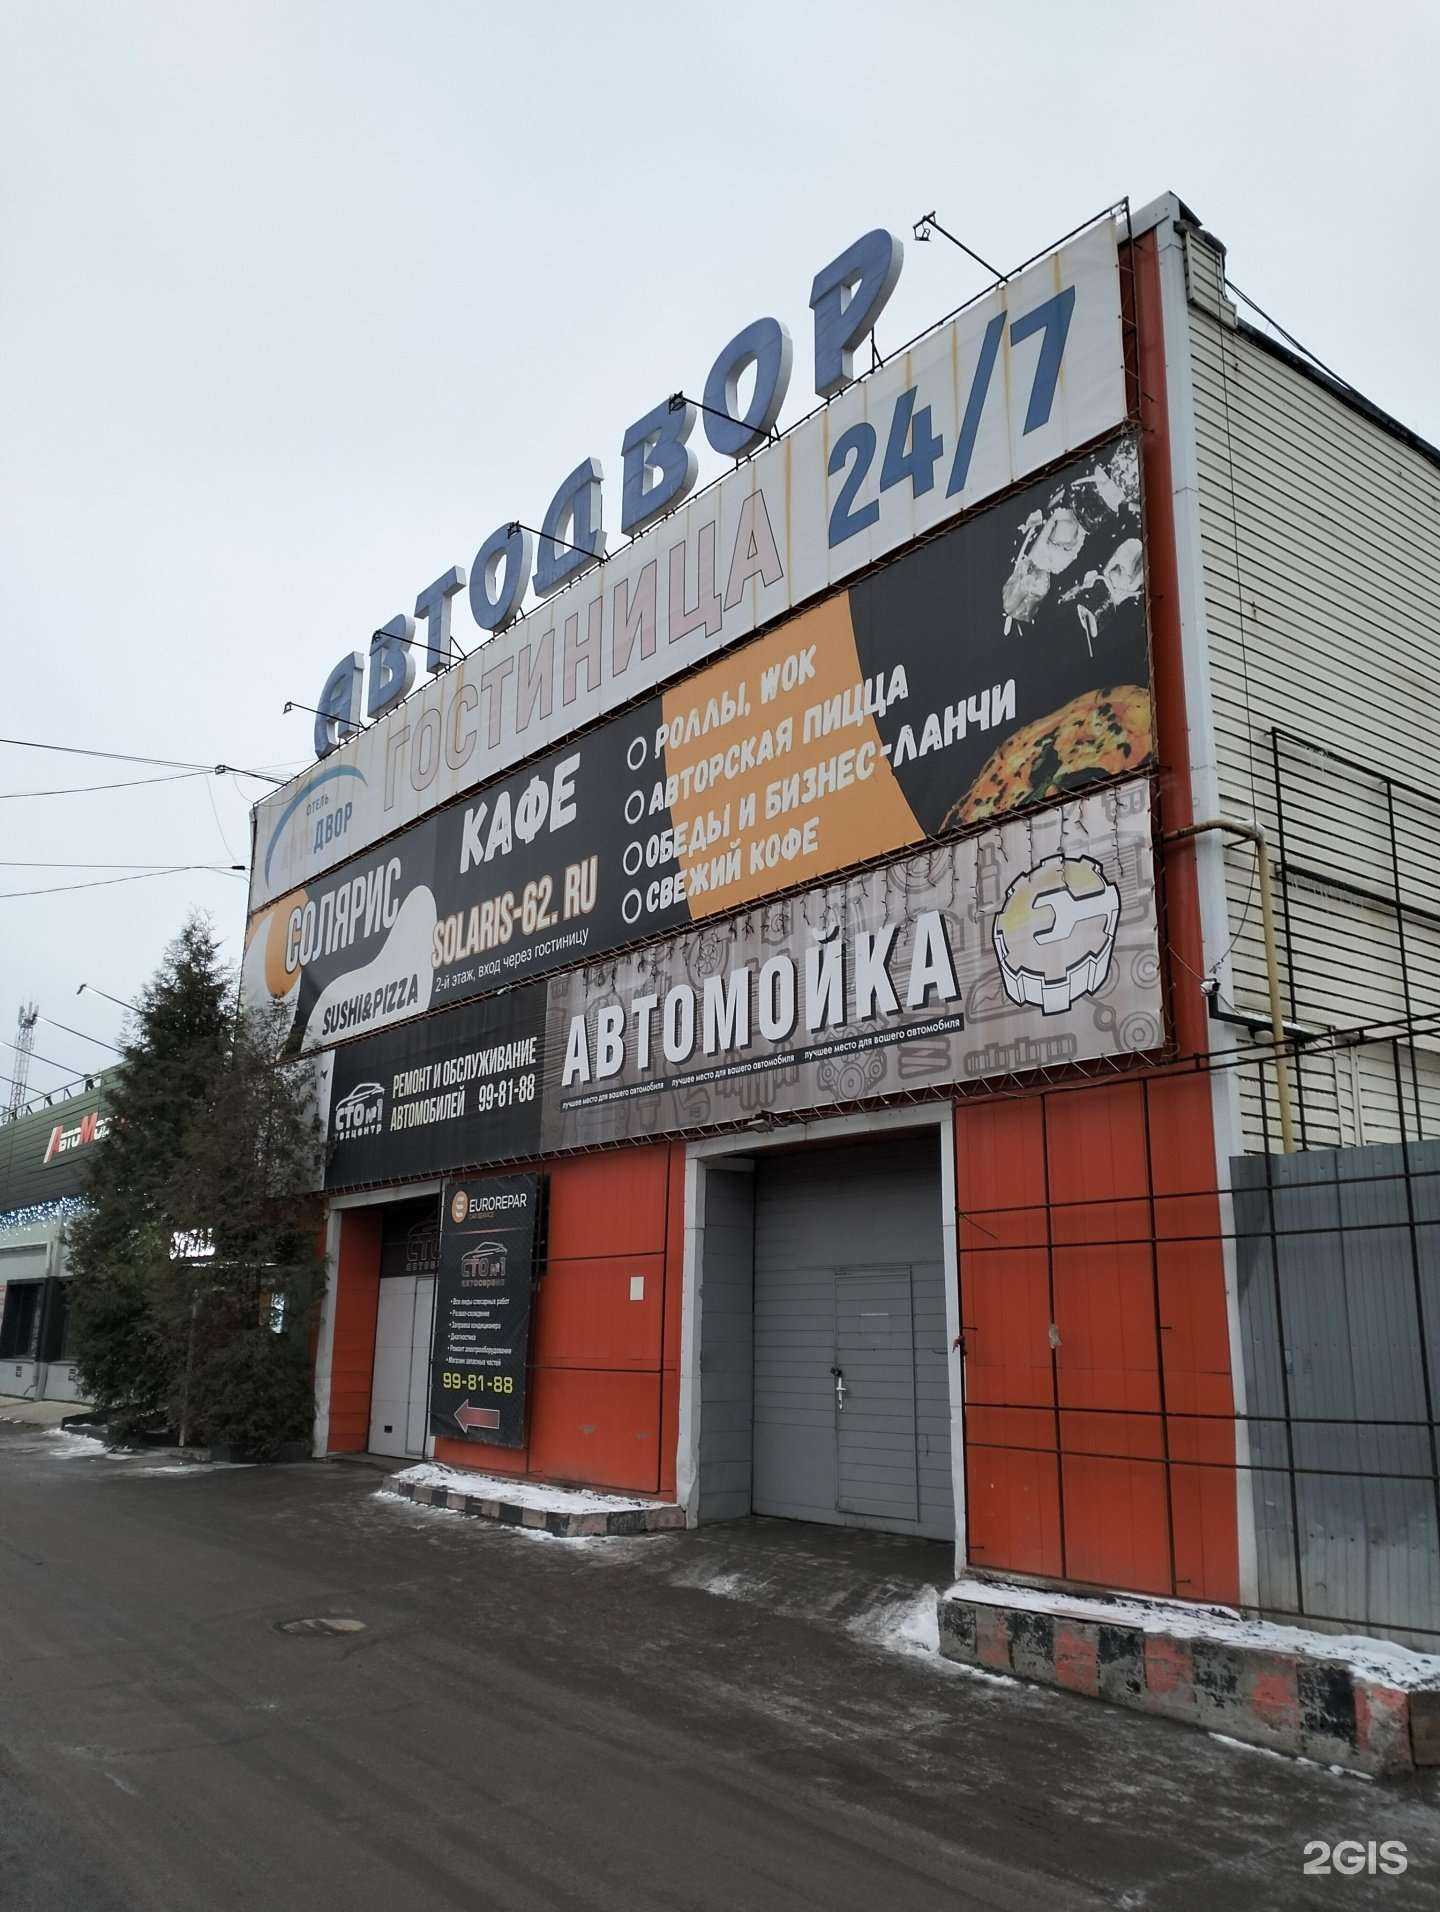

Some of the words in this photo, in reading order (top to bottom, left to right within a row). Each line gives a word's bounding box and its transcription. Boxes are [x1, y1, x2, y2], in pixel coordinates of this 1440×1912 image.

[314, 229, 904, 760] АВТОДВОР
[383, 489, 784, 813] ГОСТИНИЦА
[827, 285, 1076, 549] 24/7
[648, 717, 793, 815] АВТОРСКАЯ
[802, 664, 909, 745] ПИЦЦА
[655, 681, 750, 759] РОЛЛЫ,
[760, 643, 817, 704] WOK
[460, 752, 581, 874] КАФЕ
[645, 803, 730, 868] ОБЕДЫ
[738, 792, 756, 831] И
[765, 679, 1016, 820] БИЗНЕС-ЛАНЧИ
[313, 801, 353, 854] ДВОР
[646, 838, 742, 913] СВЕЖИЙ
[750, 816, 820, 874] КОФЕ
[285, 857, 402, 974] СОЛЯРИС
[435, 976, 451, 992] 2-й
[451, 968, 476, 987] этаж,
[478, 959, 502, 978] вход
[502, 948, 532, 969] через
[534, 928, 589, 959] гостиницу
[322, 974, 418, 1036] SUSHI&PIZZA
[561, 910, 963, 1089] АВТОМОЙКА
[805, 1046, 832, 1060] лучшее
[833, 1039, 857, 1053] место
[858, 1035, 873, 1049] для
[874, 1027, 905, 1044] вашего
[906, 1018, 960, 1037] автомобиля
[390, 1085, 466, 1131] АВТОМОБИЛЕЙ
[478, 1073, 536, 1112] 99-81-88
[392, 1065, 433, 1099] РЕМОНТ
[433, 1062, 441, 1088] И
[442, 1036, 538, 1085] ОБСЛУЖИВАНИЕ
[468, 1193, 528, 1213] EUROREPAR
[442, 1372, 514, 1394] 99-81-88
